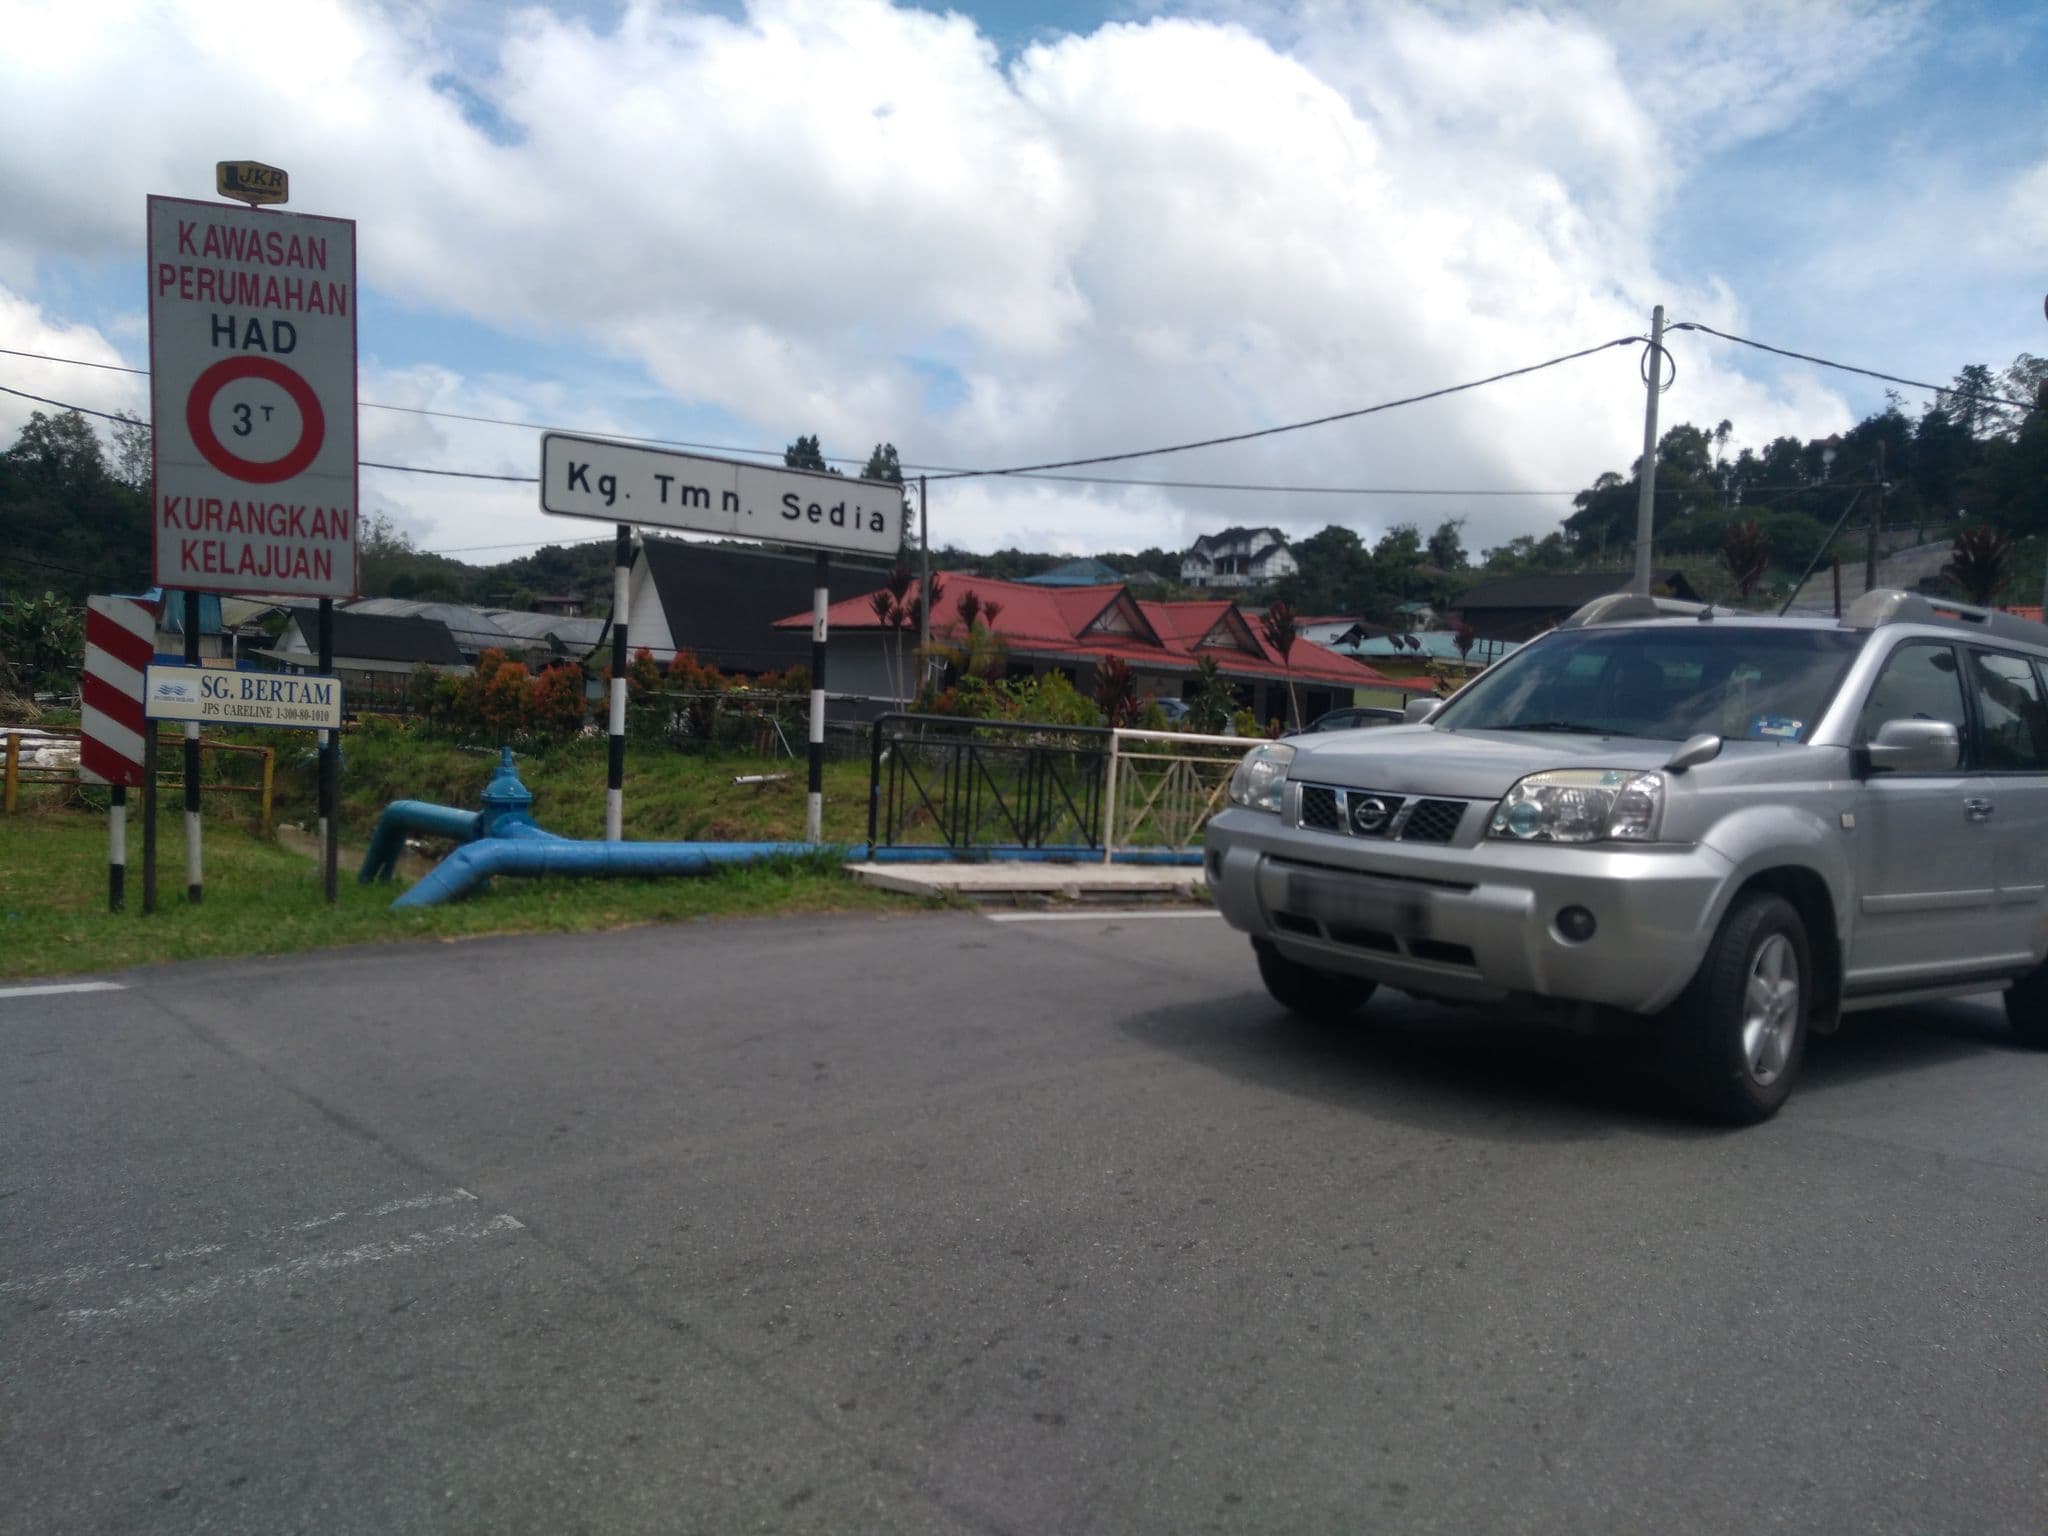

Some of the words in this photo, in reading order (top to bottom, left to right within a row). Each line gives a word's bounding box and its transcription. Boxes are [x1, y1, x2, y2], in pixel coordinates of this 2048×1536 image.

[239, 167, 283, 188] JKR
[178, 220, 327, 271] KAWASAN
[158, 263, 347, 317] PERUMAHAN
[211, 313, 297, 354] HAD
[163, 495, 349, 542] KURANGKAN
[567, 461, 631, 507] Kg.
[653, 473, 753, 516] Tmn.
[781, 493, 885, 533] Sedia
[181, 538, 332, 582] KELAJUAN
[200, 674, 235, 700] SG.
[239, 677, 333, 706] BERTAM
[202, 702, 220, 715] JPS
[223, 703, 273, 719] CARELINE
[276, 708, 330, 722] 1-300-80-1010
